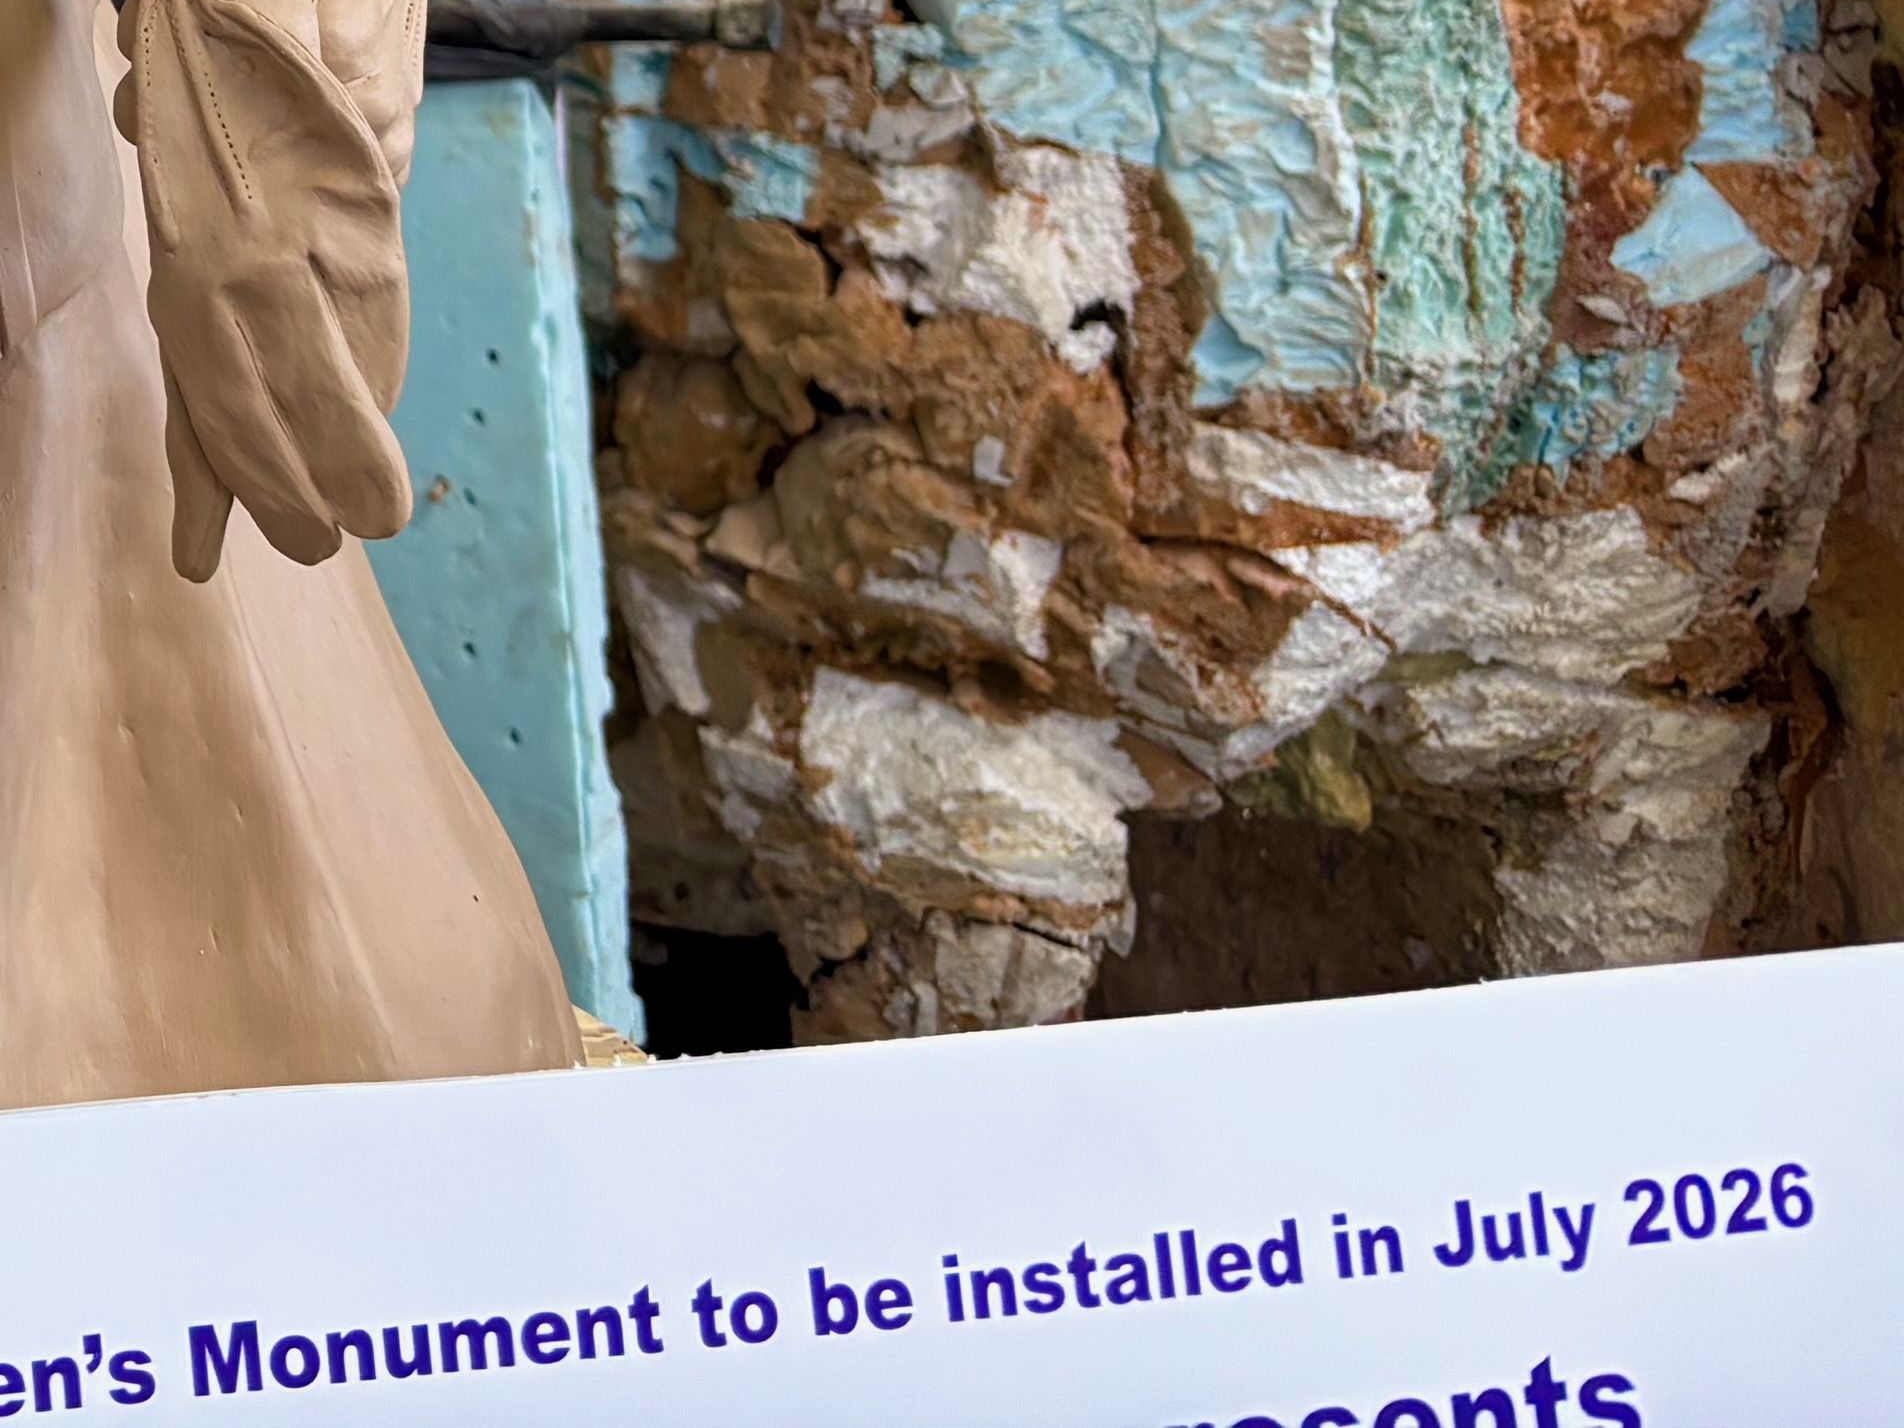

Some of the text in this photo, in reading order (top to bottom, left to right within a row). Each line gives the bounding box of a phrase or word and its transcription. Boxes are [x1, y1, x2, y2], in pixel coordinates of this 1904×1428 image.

[188, 1286, 664, 1397] Monument
[691, 1279, 779, 1348] to
[808, 1266, 913, 1336] be
[942, 1218, 1304, 1323] installed
[1332, 1213, 1404, 1279] in
[1433, 1191, 1595, 1271] July
[1623, 1163, 1814, 1246] 2026
